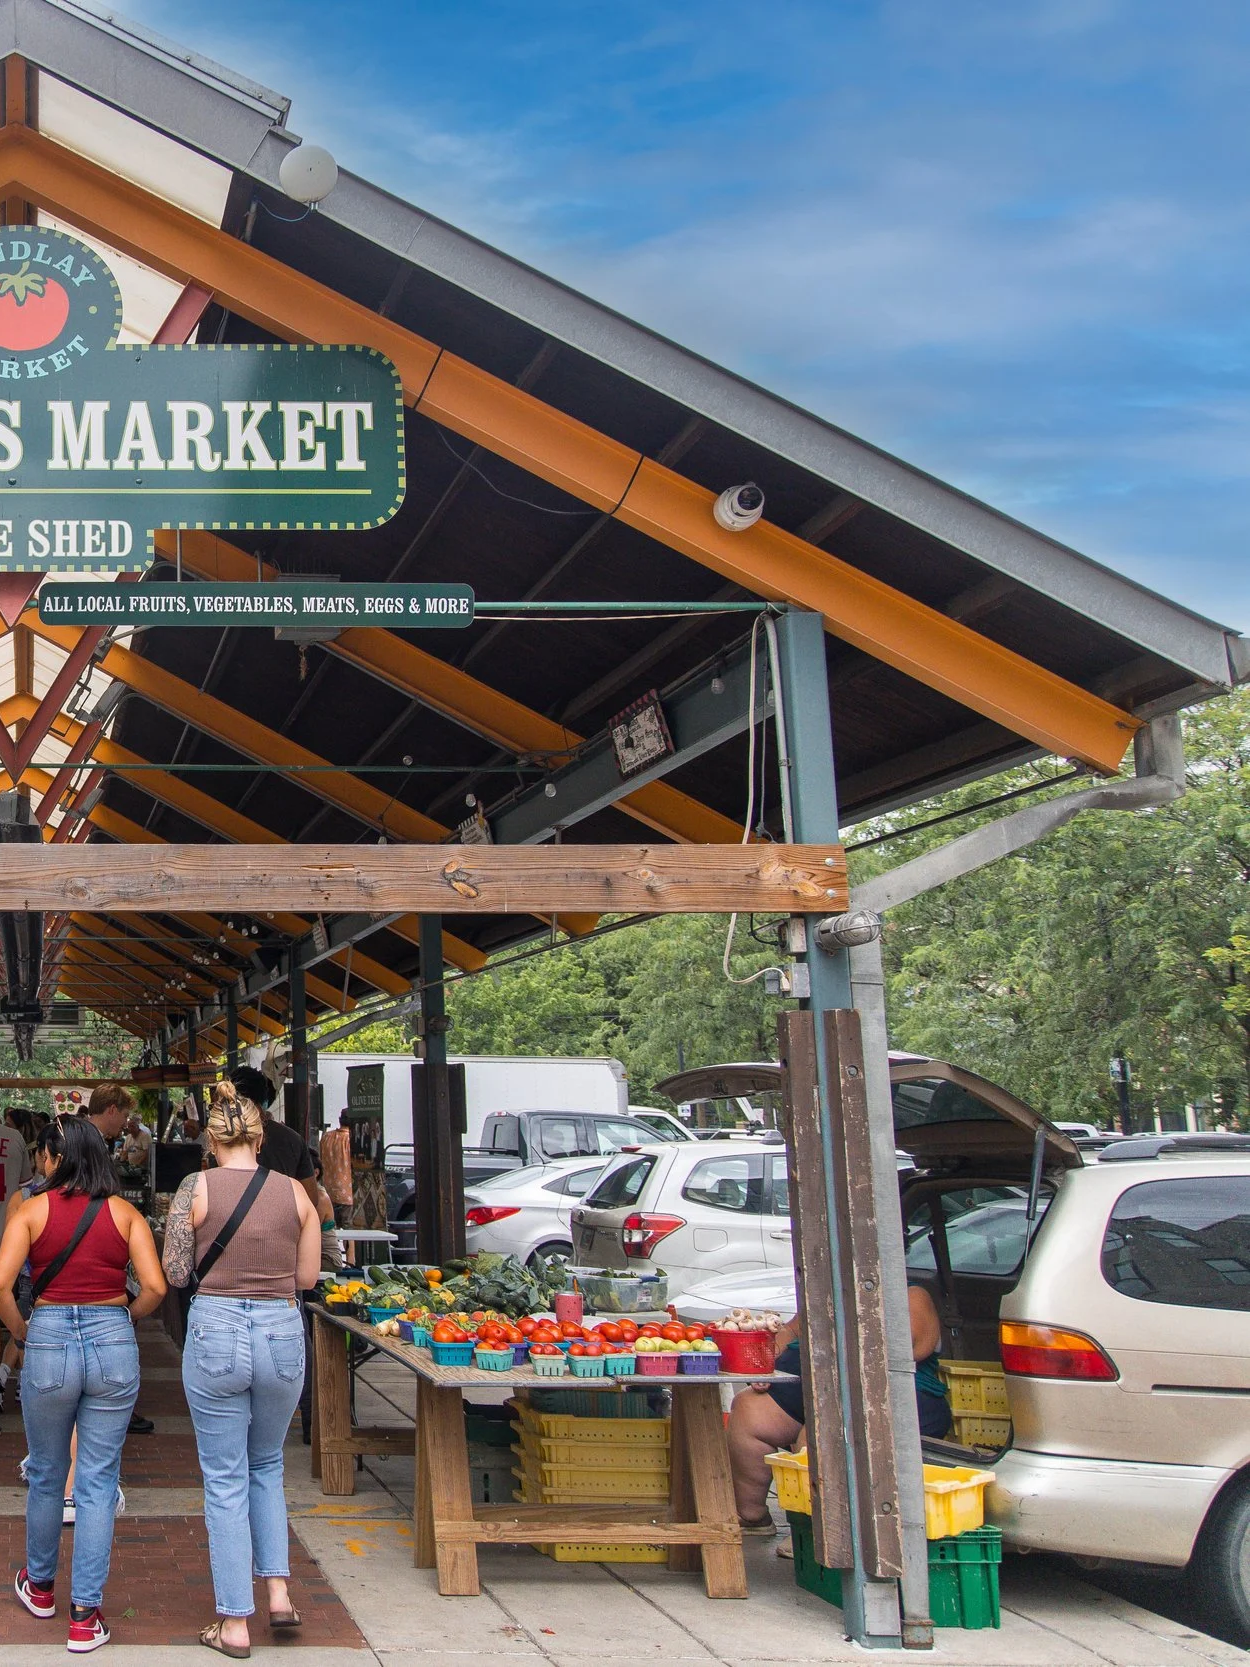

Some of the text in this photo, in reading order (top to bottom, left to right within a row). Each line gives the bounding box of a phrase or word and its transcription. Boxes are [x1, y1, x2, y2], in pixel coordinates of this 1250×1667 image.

[47, 400, 376, 473] MARKET
[28, 520, 133, 559] SHED
[43, 597, 470, 616] ALL LOCAL FRUITS, VEGETABLES, MEATS, EGGS & MORE
[351, 1094, 381, 1106] OLIVE TREE
